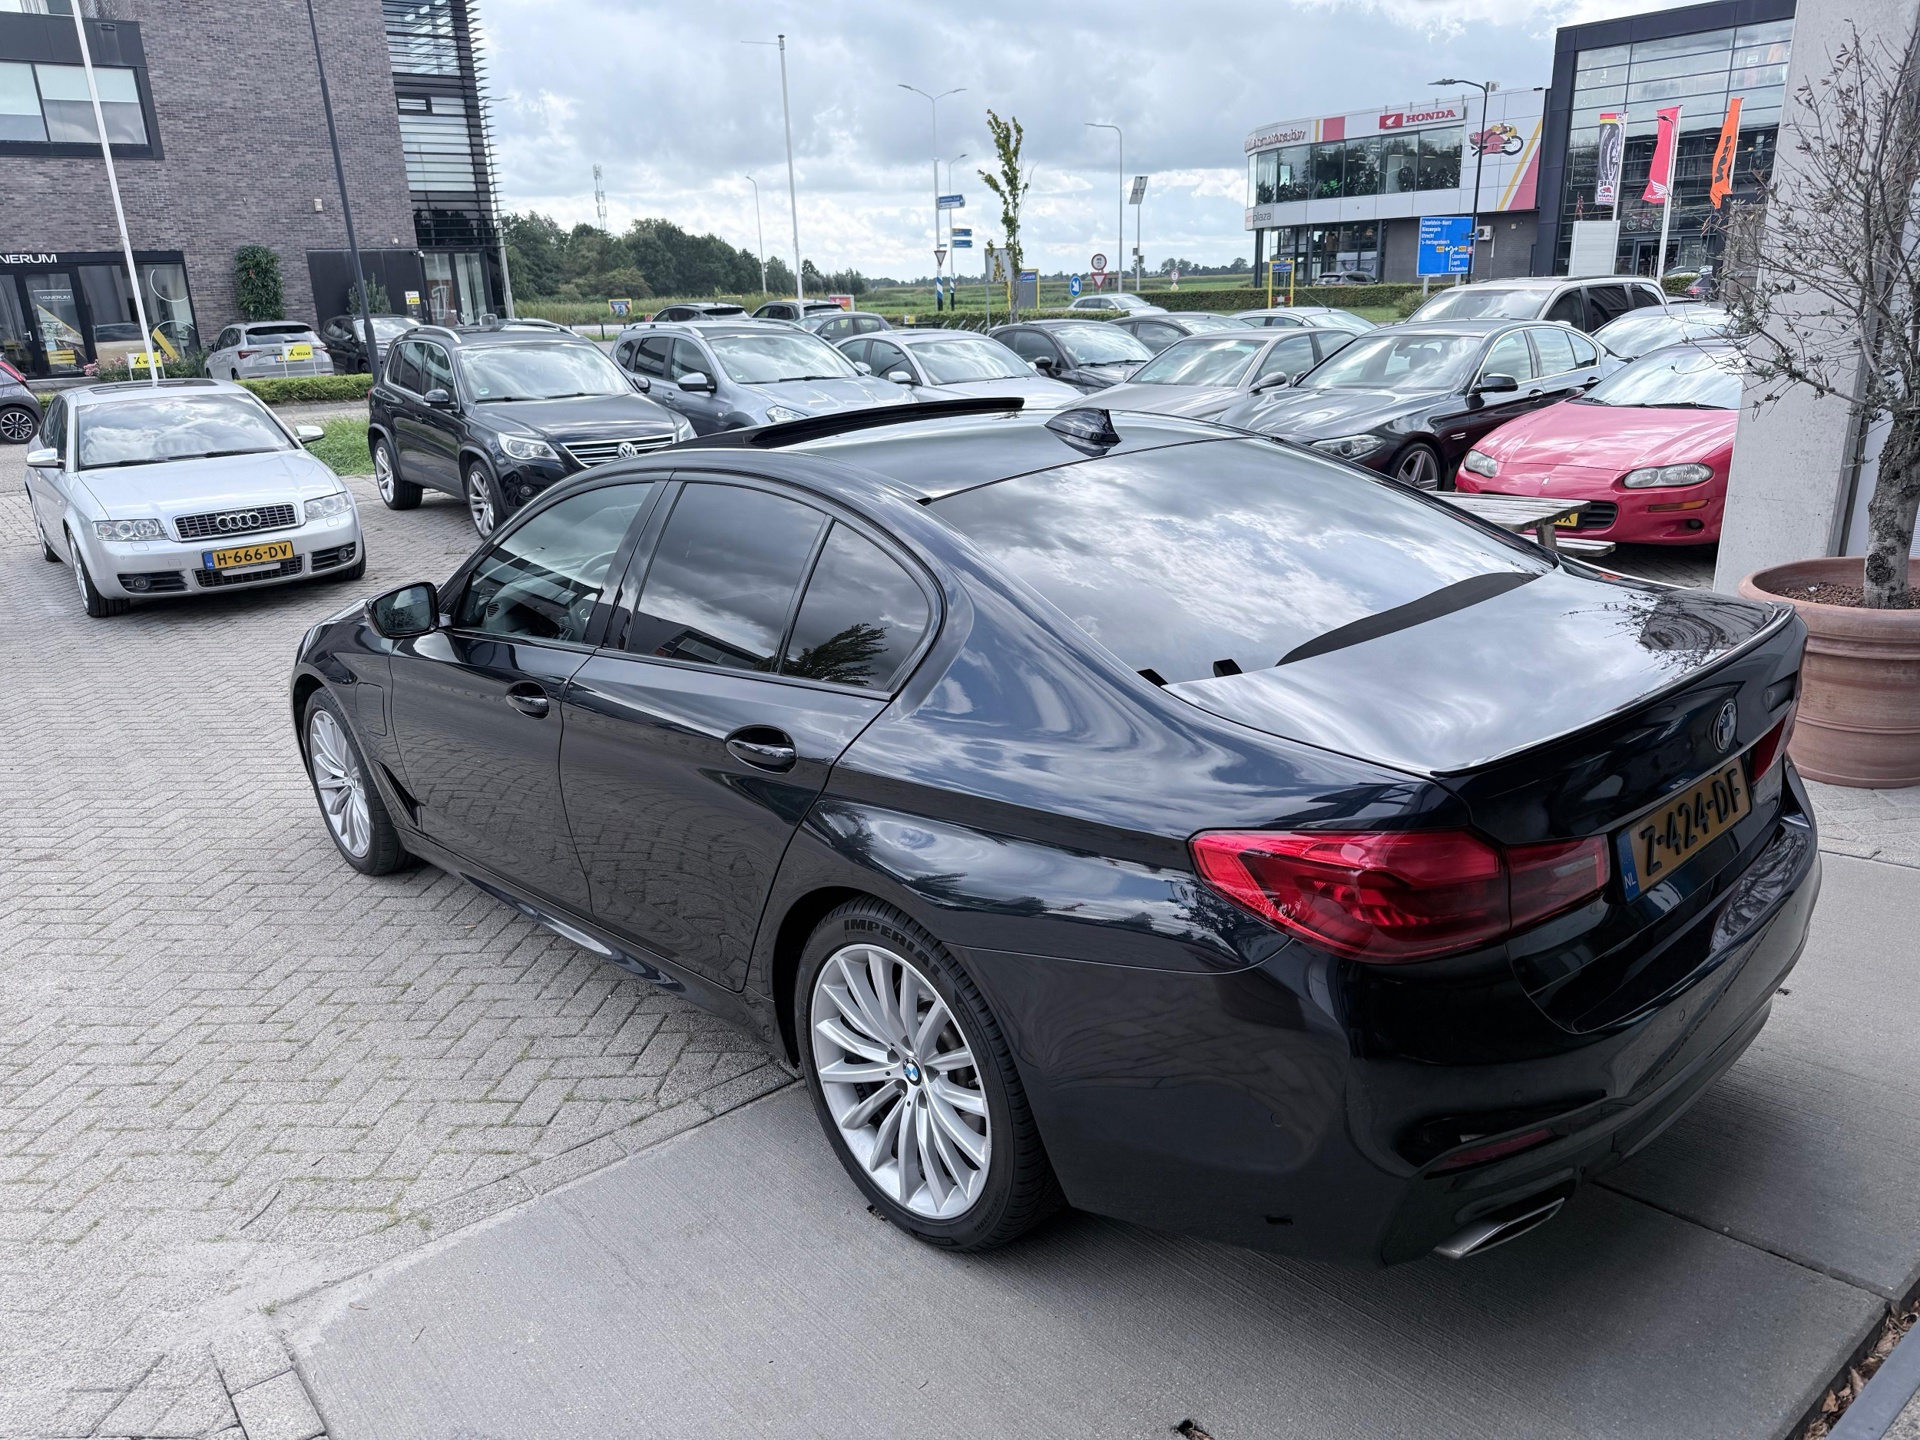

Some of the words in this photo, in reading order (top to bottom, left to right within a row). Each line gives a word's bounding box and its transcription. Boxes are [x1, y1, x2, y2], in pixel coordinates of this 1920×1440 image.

[1405, 109, 1456, 123] HONDA
[216, 544, 288, 566] H-666-DV
[1623, 872, 1637, 890] NL
[1638, 767, 1741, 877] Z-424-DF
[843, 918, 941, 981] IMPERIAL
